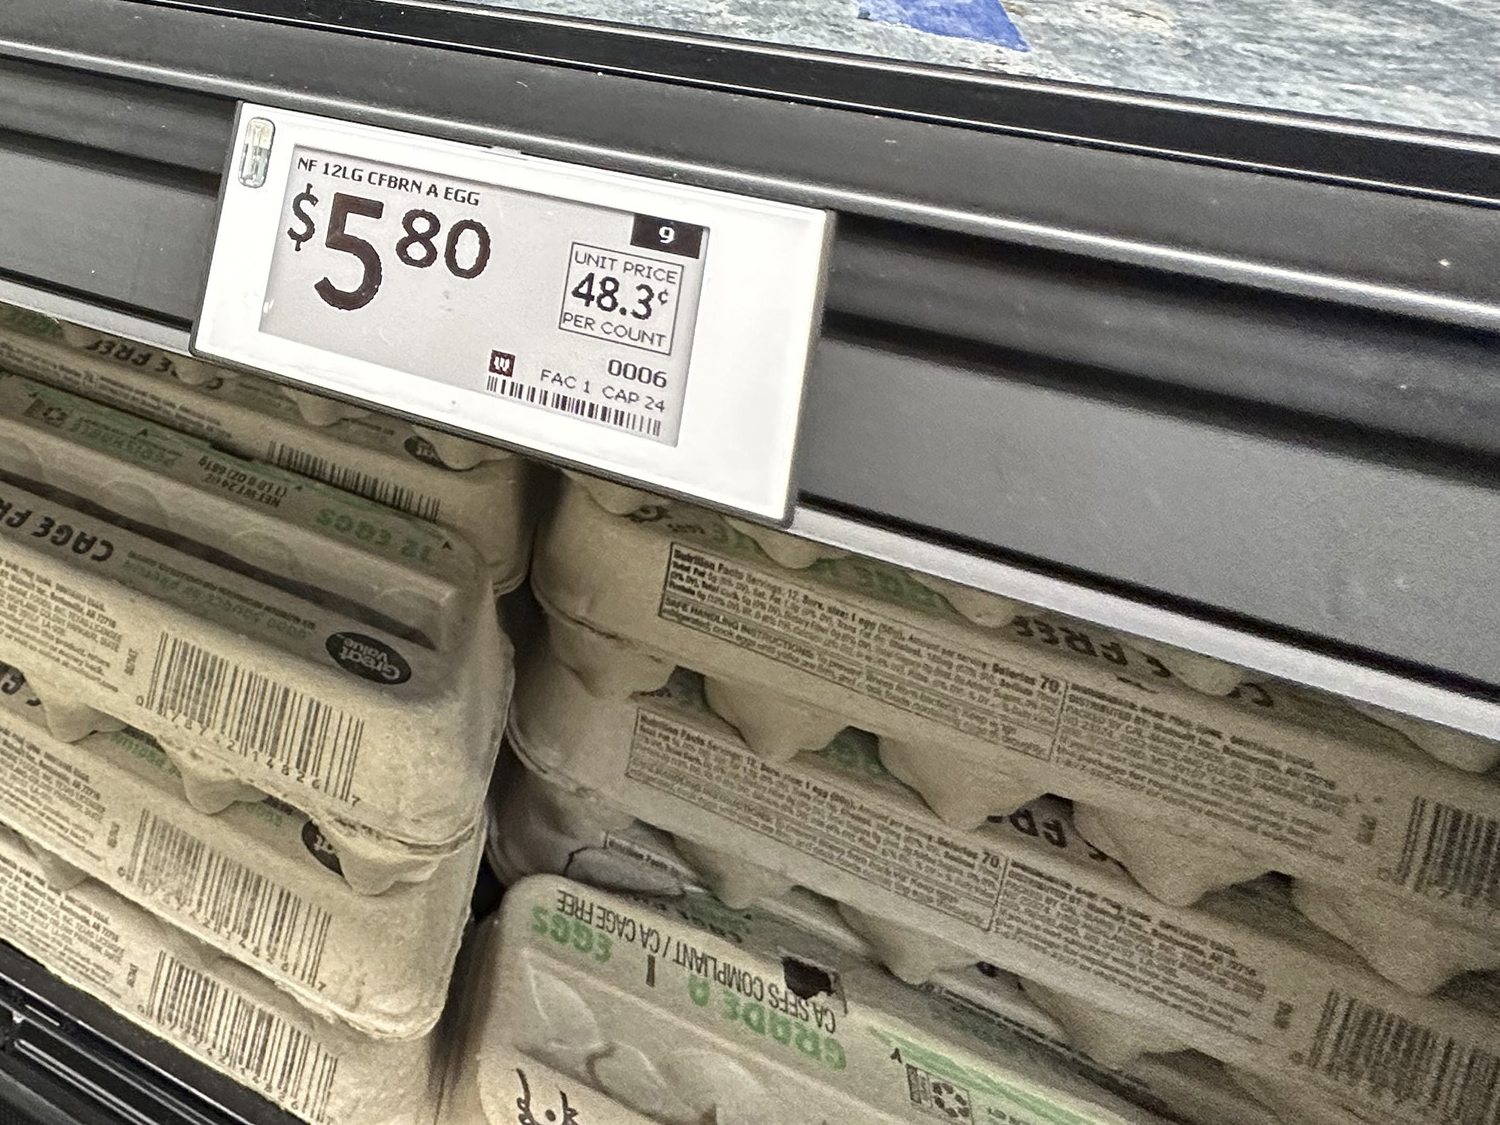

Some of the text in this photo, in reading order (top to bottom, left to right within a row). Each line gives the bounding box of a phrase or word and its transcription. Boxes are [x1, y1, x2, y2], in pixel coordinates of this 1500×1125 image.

[298, 157, 480, 206] NF 12LG CFBRN A EGG
[659, 226, 675, 243] 9
[574, 251, 678, 284] UNIT PRICE
[571, 272, 668, 320] 48.3¢
[562, 312, 666, 347] PER COUNT
[540, 369, 576, 389] FAC
[584, 381, 590, 393] 1
[602, 386, 640, 404] CAP
[645, 397, 665, 412] 24
[608, 359, 667, 388] 0006
[31, 516, 115, 564] CAGE
[315, 509, 432, 563] 12 EGGS
[339, 646, 401, 681] Great
[342, 637, 389, 662] Value
[351, 794, 361, 806] 7
[557, 888, 593, 924] FREE
[597, 906, 635, 941] CAGE
[640, 922, 660, 954] CA
[531, 904, 846, 1070] GRADE A EGGS
[673, 941, 764, 1002] COMPLIANT
[812, 1000, 836, 1034] CA
